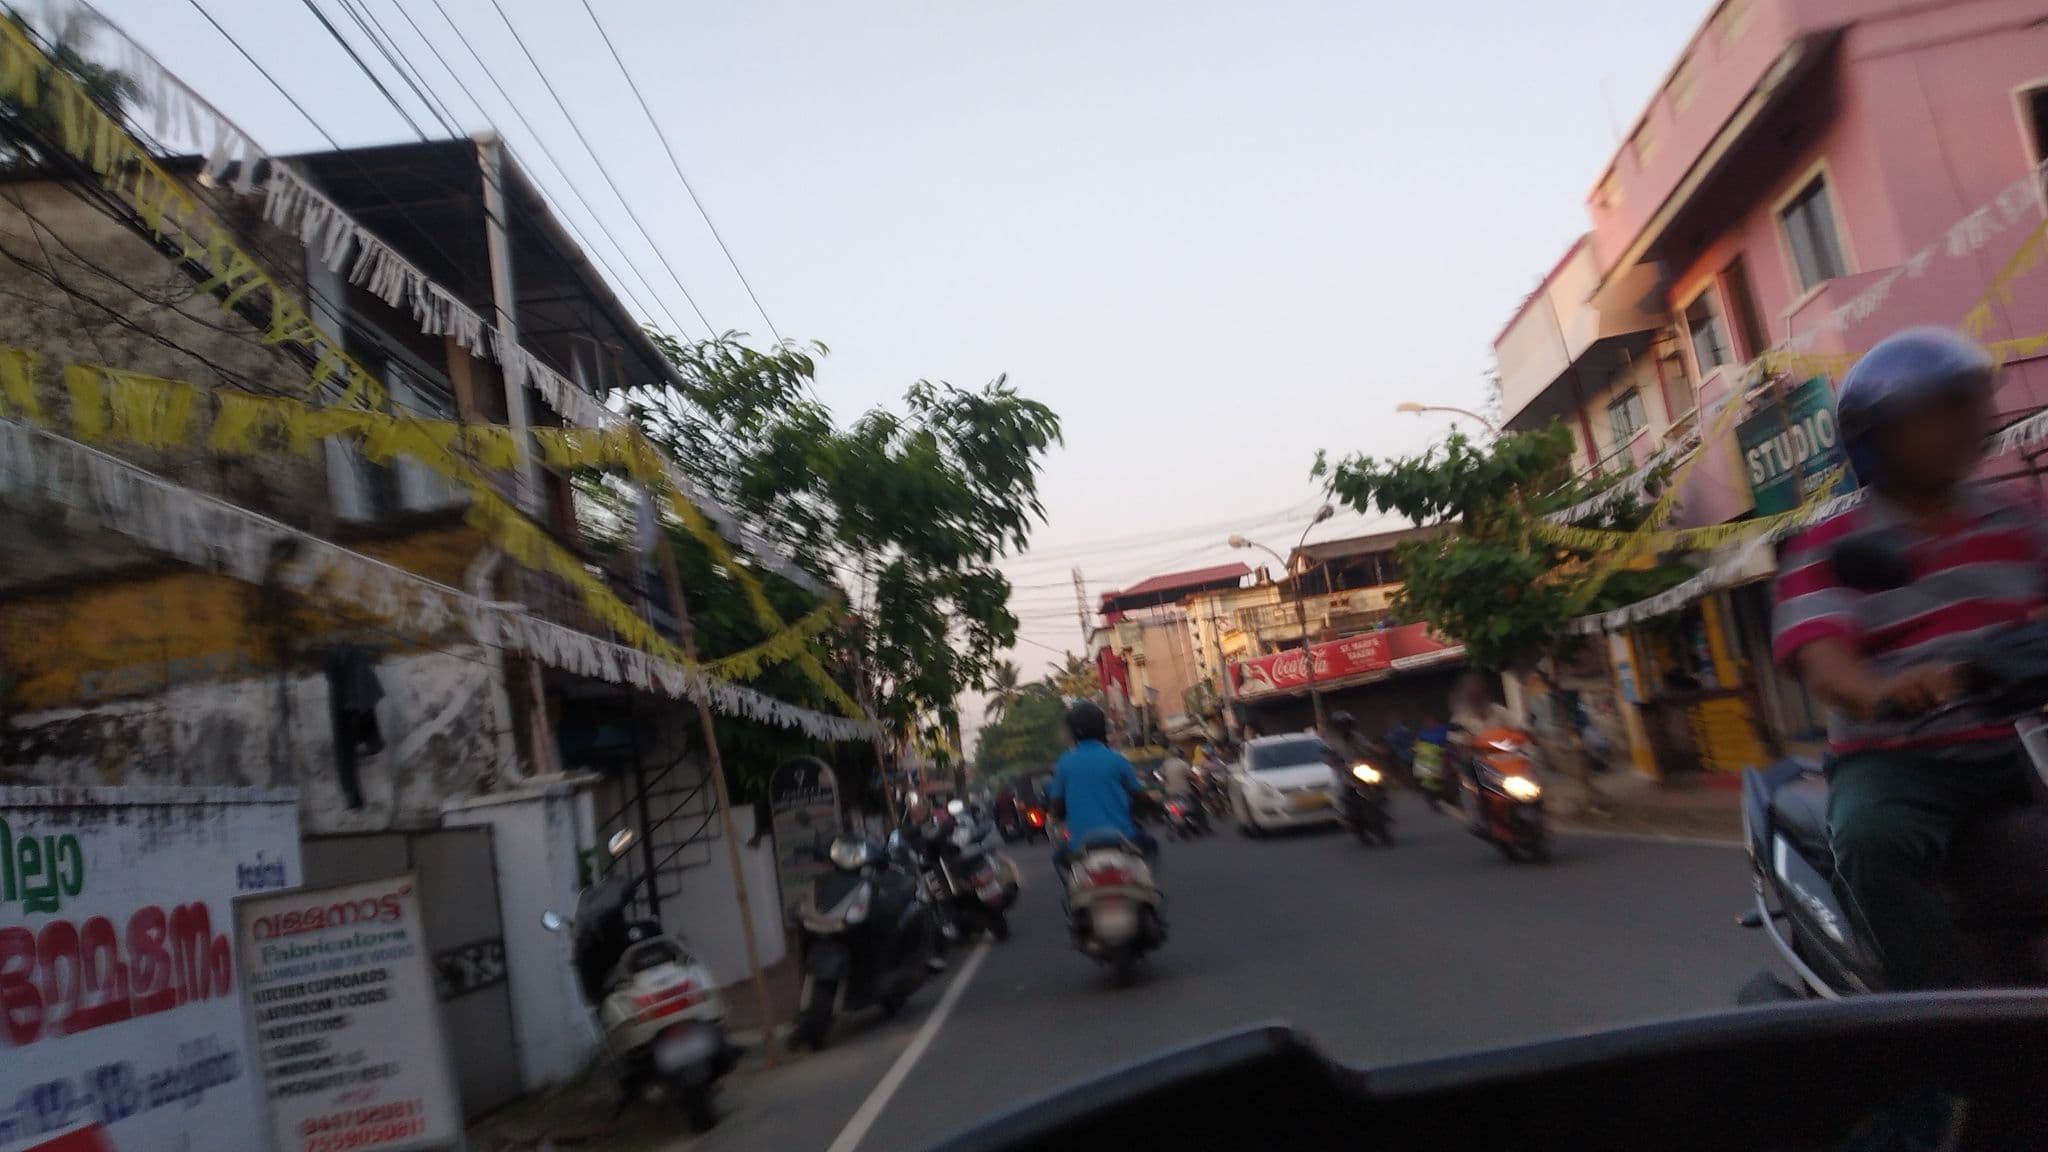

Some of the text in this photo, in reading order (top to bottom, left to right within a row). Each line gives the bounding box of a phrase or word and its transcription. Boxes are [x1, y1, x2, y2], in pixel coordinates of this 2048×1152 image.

[1746, 408, 1836, 485] STUDIO
[252, 967, 388, 1005] KITCHEN CUPBOARDS
